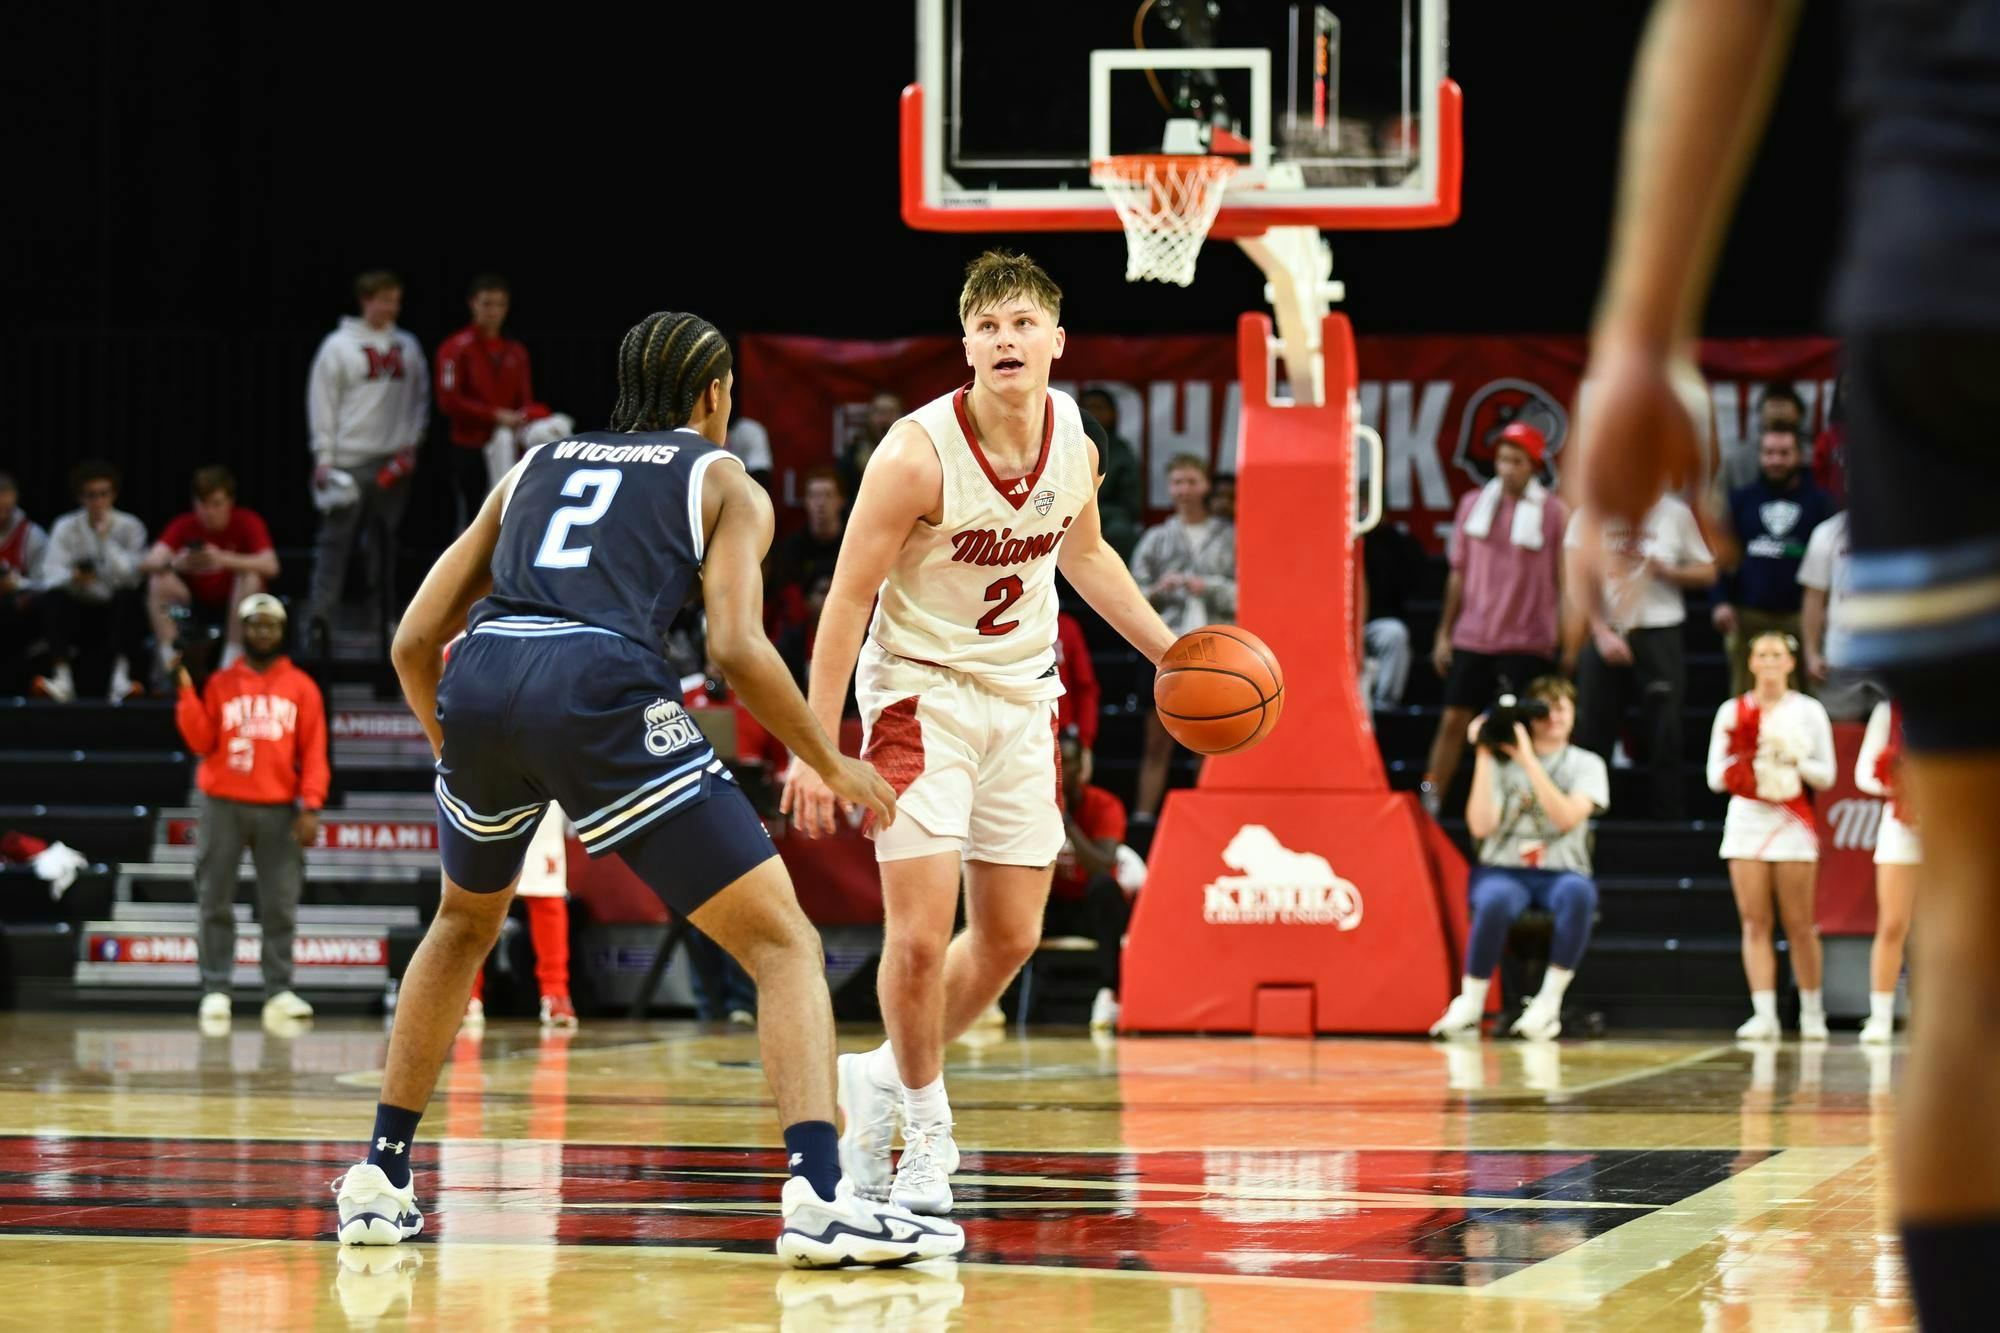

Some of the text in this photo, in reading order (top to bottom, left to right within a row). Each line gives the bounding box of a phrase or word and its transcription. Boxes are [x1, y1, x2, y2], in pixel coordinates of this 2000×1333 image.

[553, 441, 680, 465] WIGGINS
[533, 468, 623, 569] 2
[951, 516, 1073, 567] Miami
[976, 574, 1024, 635] 2
[221, 694, 298, 734] MIAMI
[646, 717, 703, 755] ODU
[338, 824, 432, 848] MIAMI
